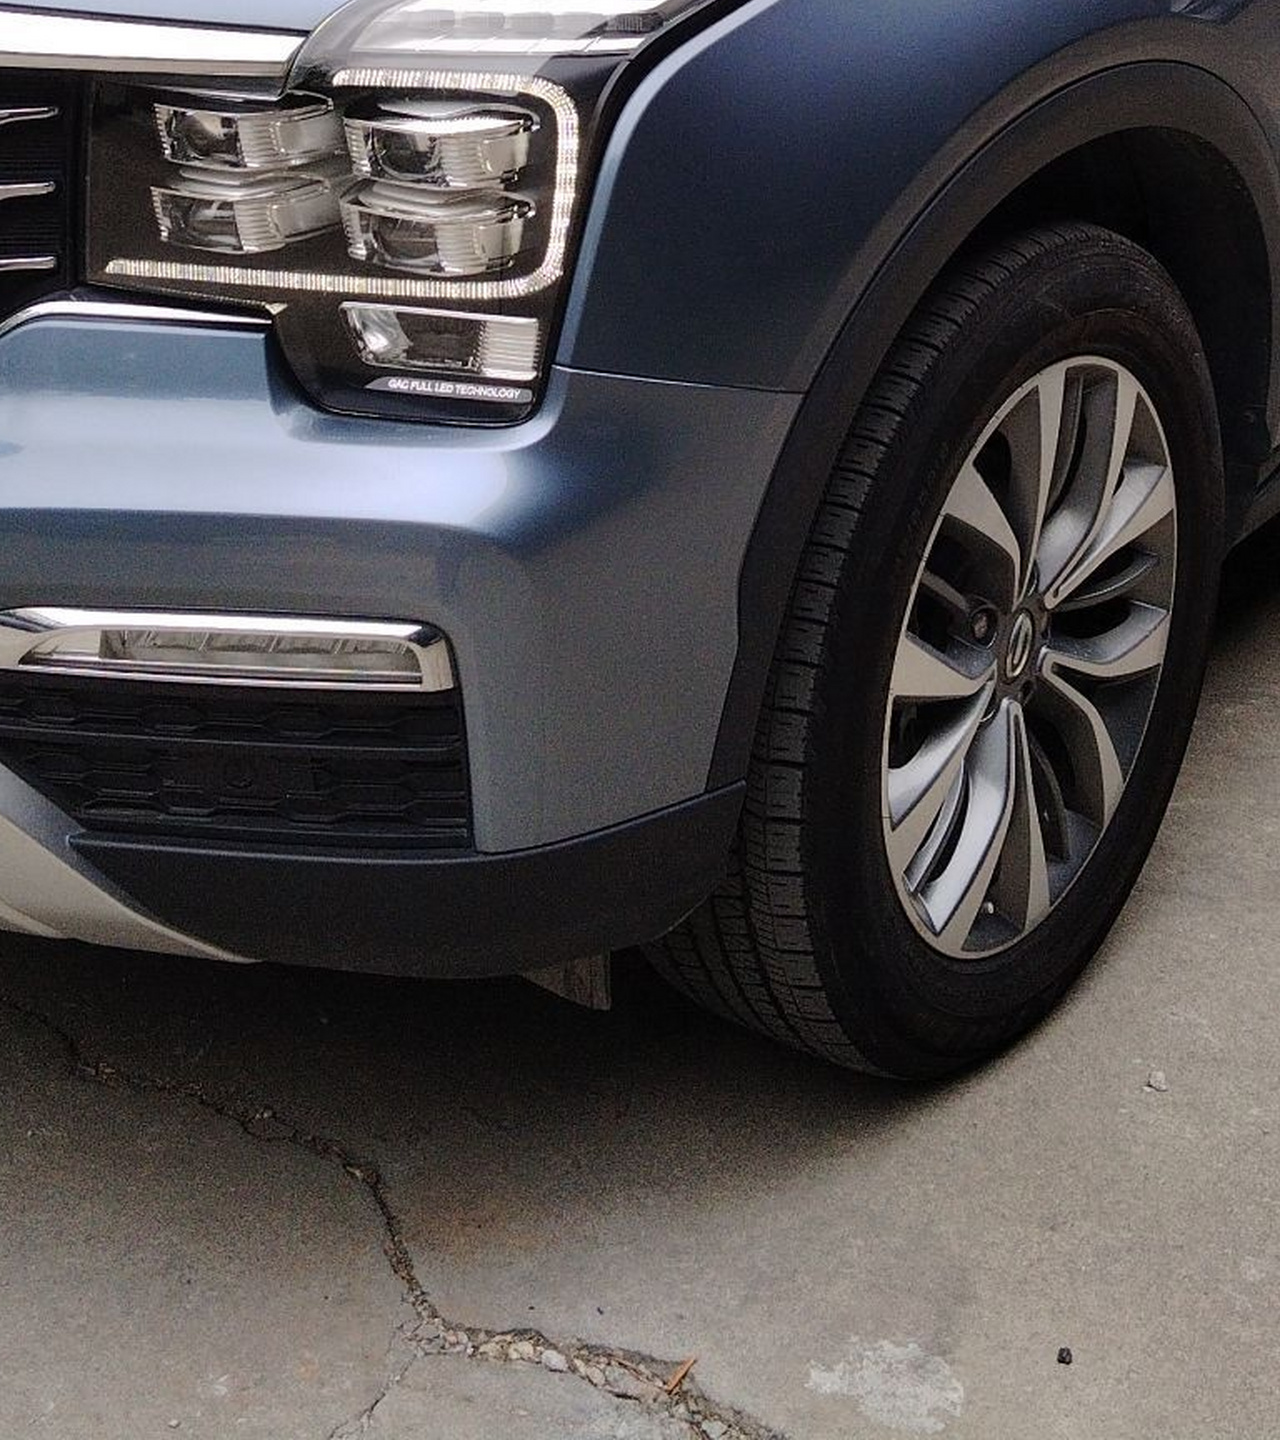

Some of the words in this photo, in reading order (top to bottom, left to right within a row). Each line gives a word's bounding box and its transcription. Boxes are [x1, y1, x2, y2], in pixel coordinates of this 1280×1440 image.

[387, 378, 409, 390] GAC
[410, 380, 432, 392] FULL
[435, 382, 453, 394] LED
[455, 384, 521, 399] TECHNOLOGY
